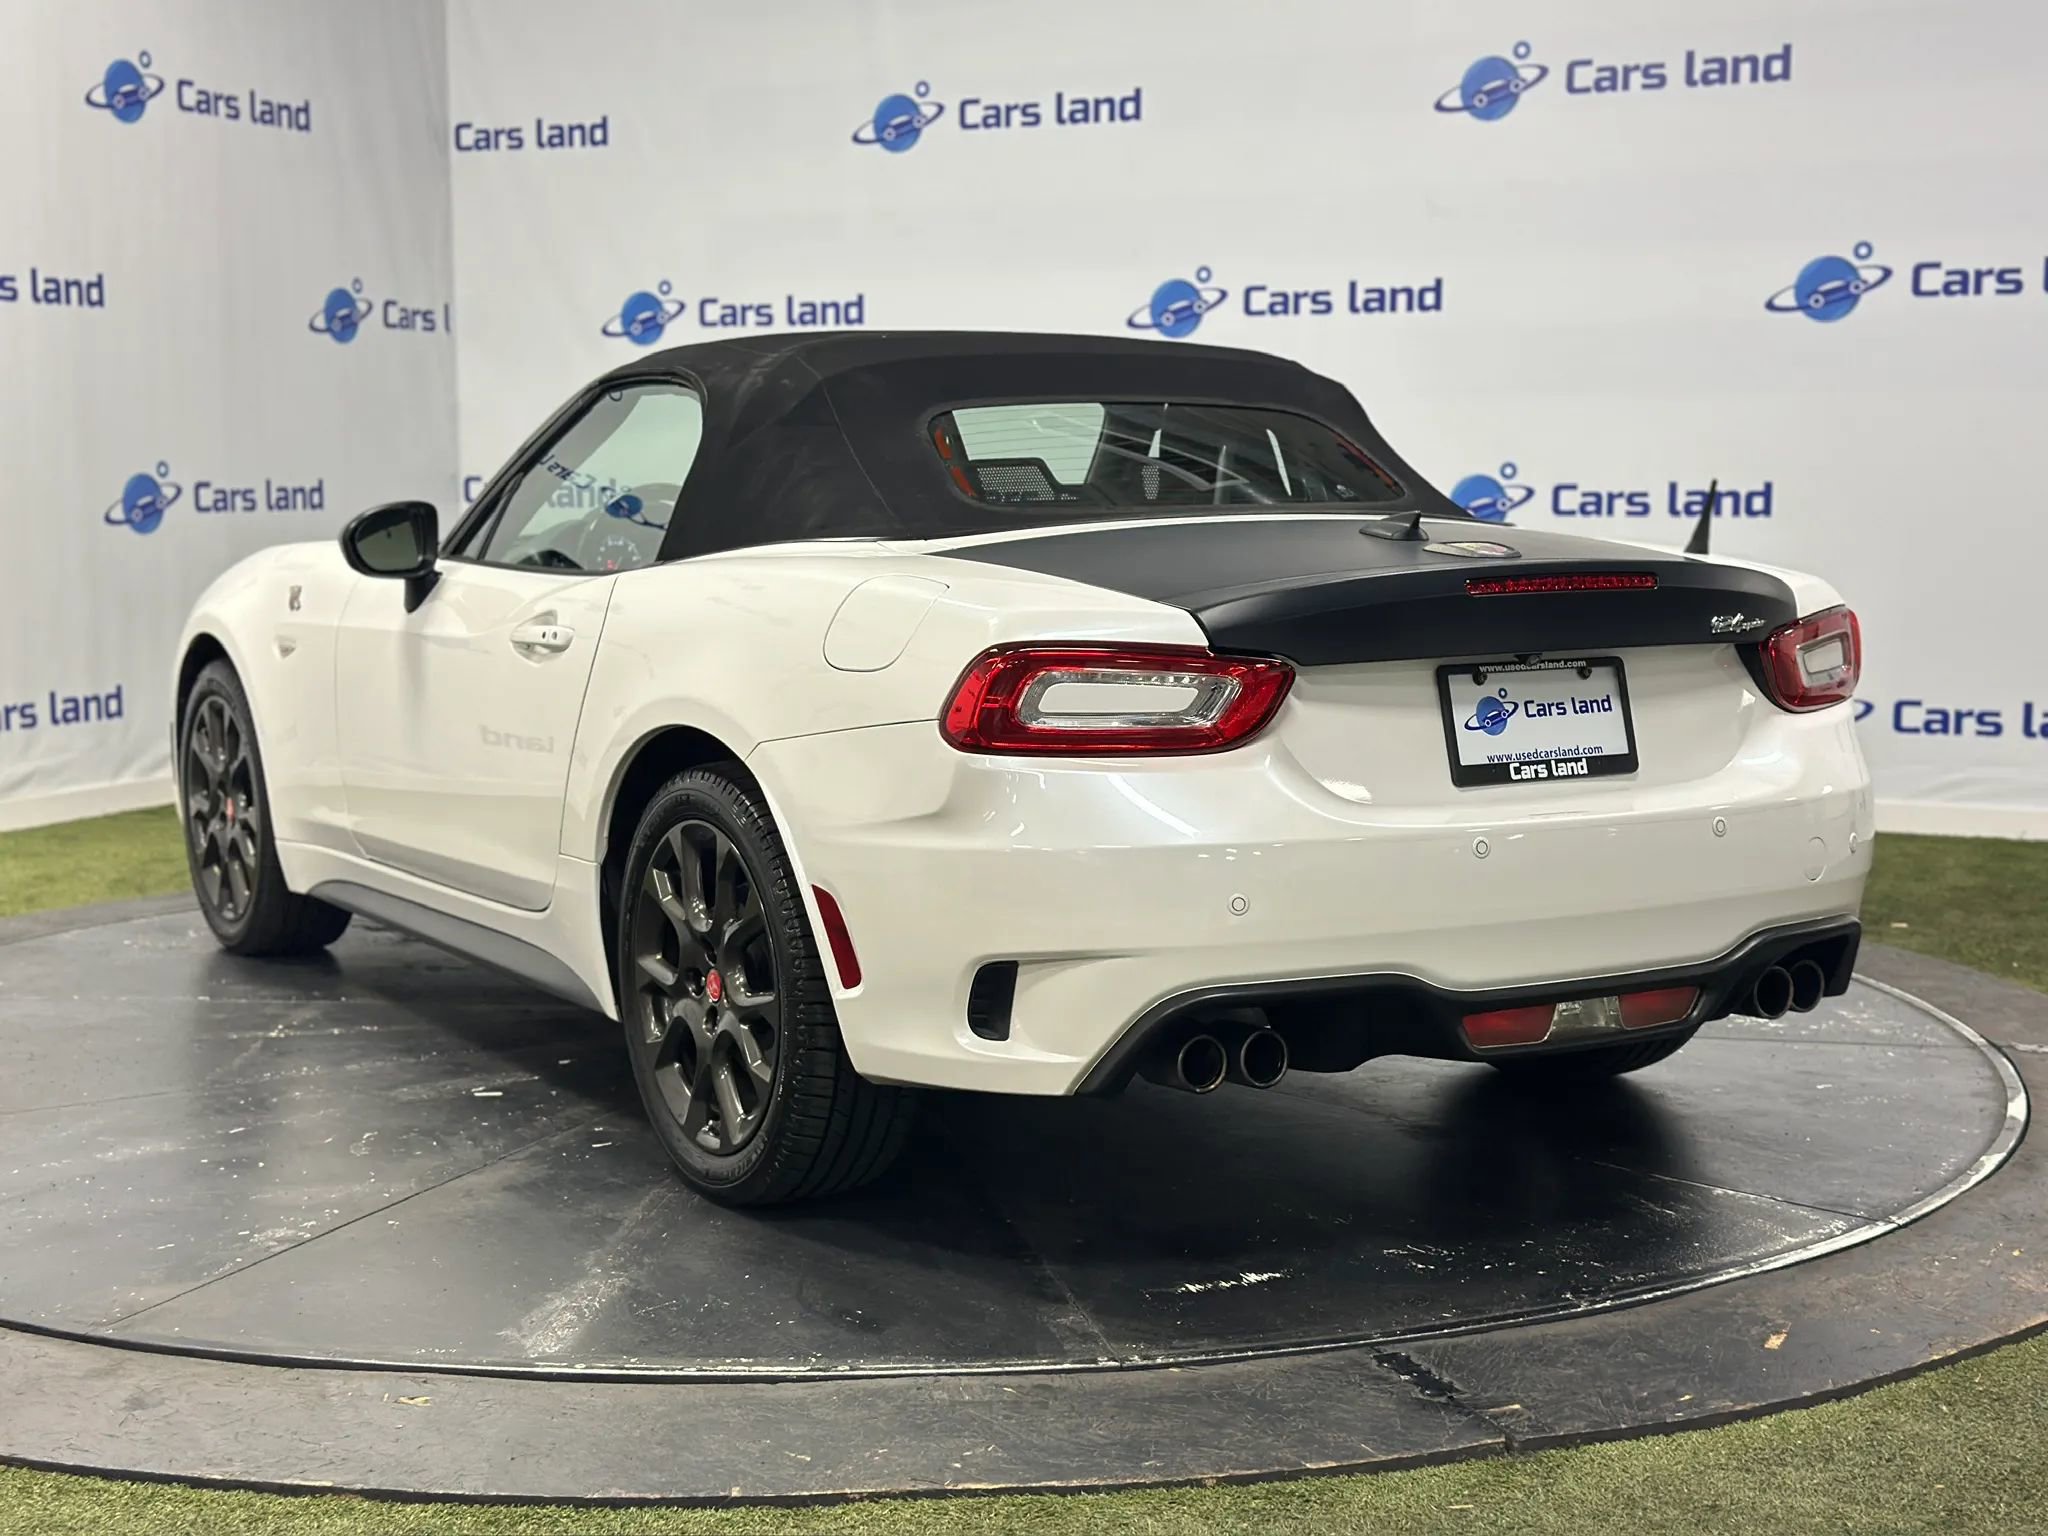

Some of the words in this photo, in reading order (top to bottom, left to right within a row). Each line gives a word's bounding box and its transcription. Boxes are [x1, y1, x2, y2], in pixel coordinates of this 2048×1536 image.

[1565, 59, 1668, 95] Cars
[1684, 43, 1793, 88] land
[176, 78, 241, 121] Cars
[249, 89, 311, 132] land
[959, 98, 1042, 130] Cars
[1055, 87, 1142, 126] land
[454, 122, 524, 152] Cars
[536, 115, 609, 149] land
[30, 267, 105, 308] land
[1243, 285, 1333, 317] Cars
[1348, 277, 1443, 314] land
[1911, 261, 2024, 297] Cars
[382, 299, 436, 332] Cars
[698, 297, 774, 328] Cars
[786, 293, 864, 326] land
[193, 481, 257, 513] Cars
[265, 479, 324, 512] land
[1551, 484, 1651, 517] Cars
[1668, 481, 1773, 519] land
[0, 702, 38, 731] rs
[49, 684, 124, 726] land
[1523, 699, 1567, 719] Cars
[1571, 693, 1613, 714] land
[1893, 700, 2003, 737] Cars
[1486, 744, 1604, 763] www.usedcarsland.com
[1509, 762, 1548, 780] Cars
[1550, 758, 1588, 776] land
